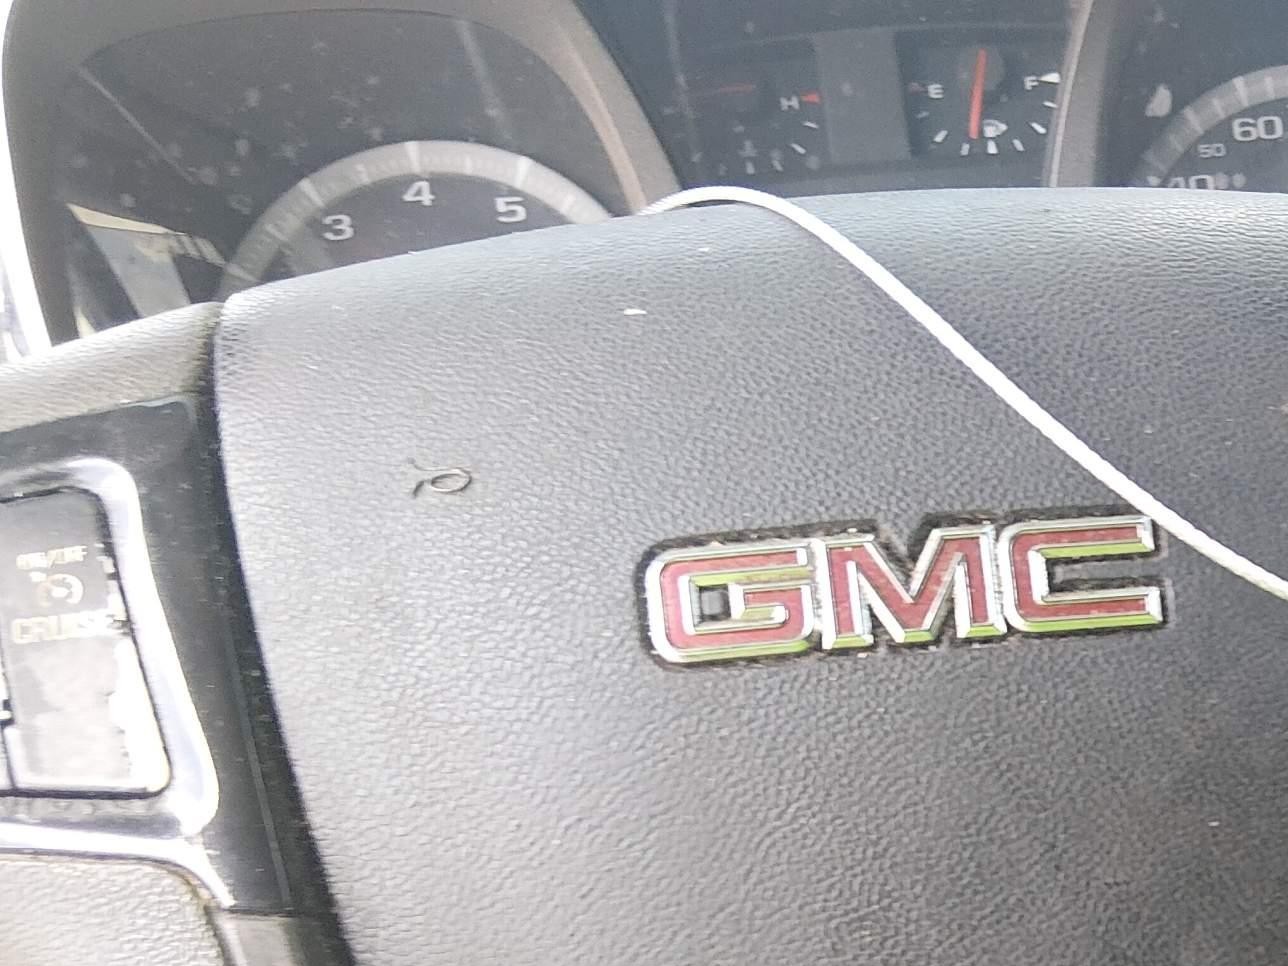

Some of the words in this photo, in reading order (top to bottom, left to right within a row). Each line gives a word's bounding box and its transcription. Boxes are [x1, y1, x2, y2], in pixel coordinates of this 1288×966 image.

[927, 83, 944, 99] E
[1231, 116, 1284, 142] 60
[402, 180, 436, 206] 4
[494, 196, 527, 223] 5
[321, 214, 354, 241] 3
[644, 514, 1163, 663] GMC
